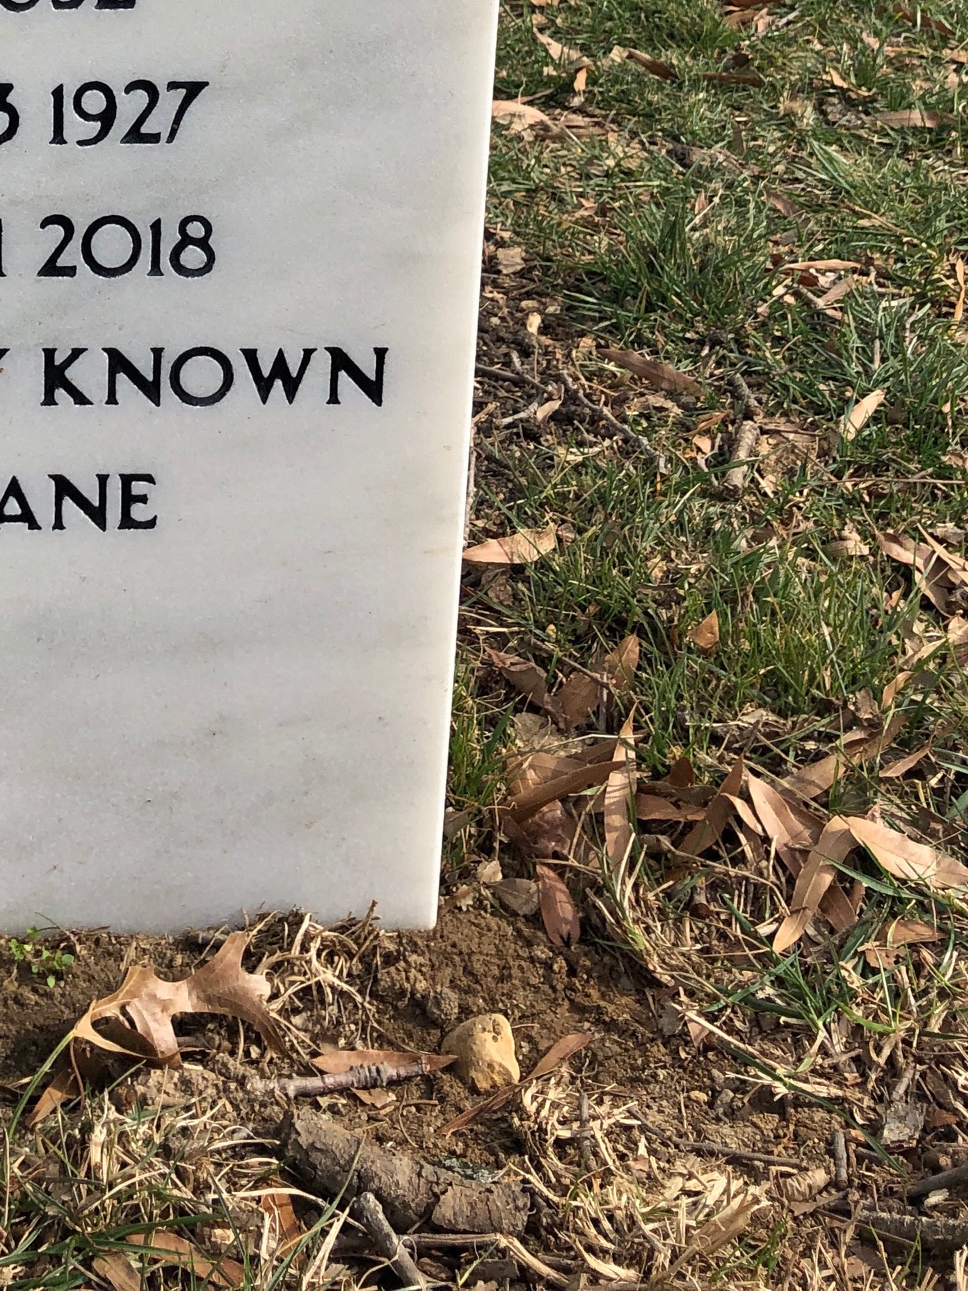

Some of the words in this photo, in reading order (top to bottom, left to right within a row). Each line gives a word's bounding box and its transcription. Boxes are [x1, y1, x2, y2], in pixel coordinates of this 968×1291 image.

[49, 78, 209, 147] 1927
[37, 213, 216, 279] 2018
[40, 345, 389, 408] KNOWN
